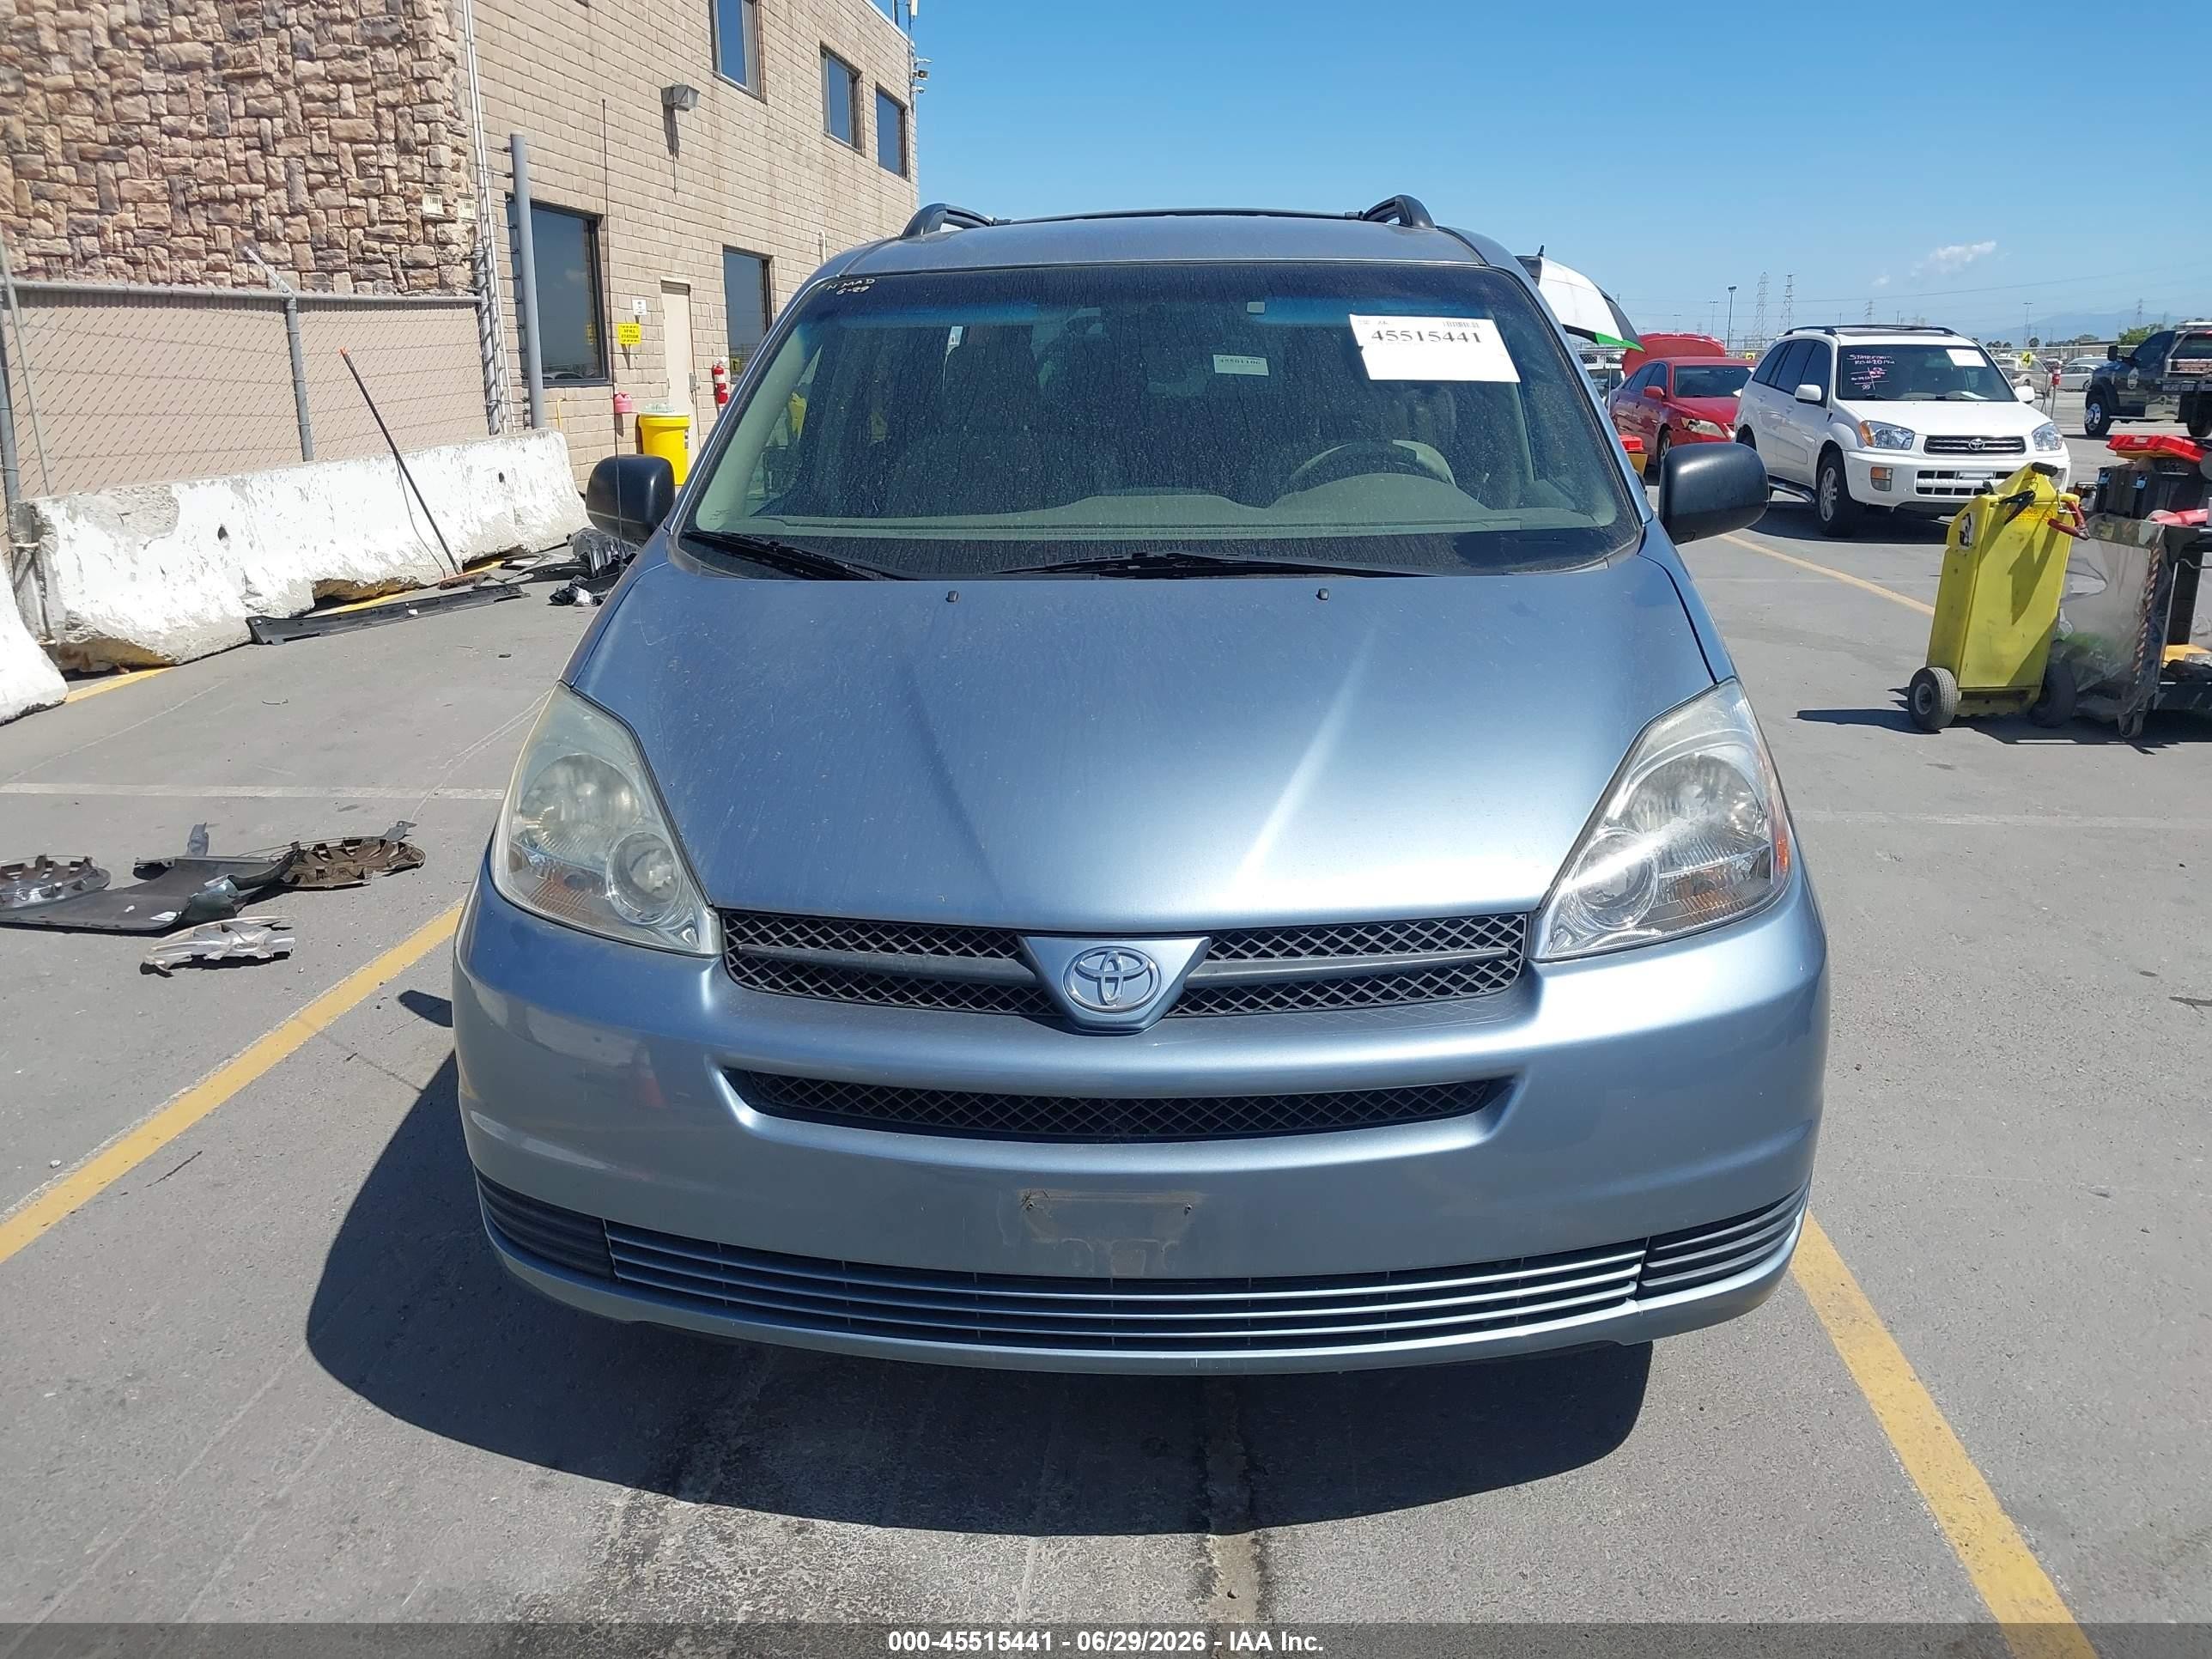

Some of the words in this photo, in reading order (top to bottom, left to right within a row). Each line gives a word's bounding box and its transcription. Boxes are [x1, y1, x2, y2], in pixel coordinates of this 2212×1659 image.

[836, 285, 870, 295] 6-29
[1371, 330, 1482, 343] 45515441
[2022, 353, 2031, 363] 4
